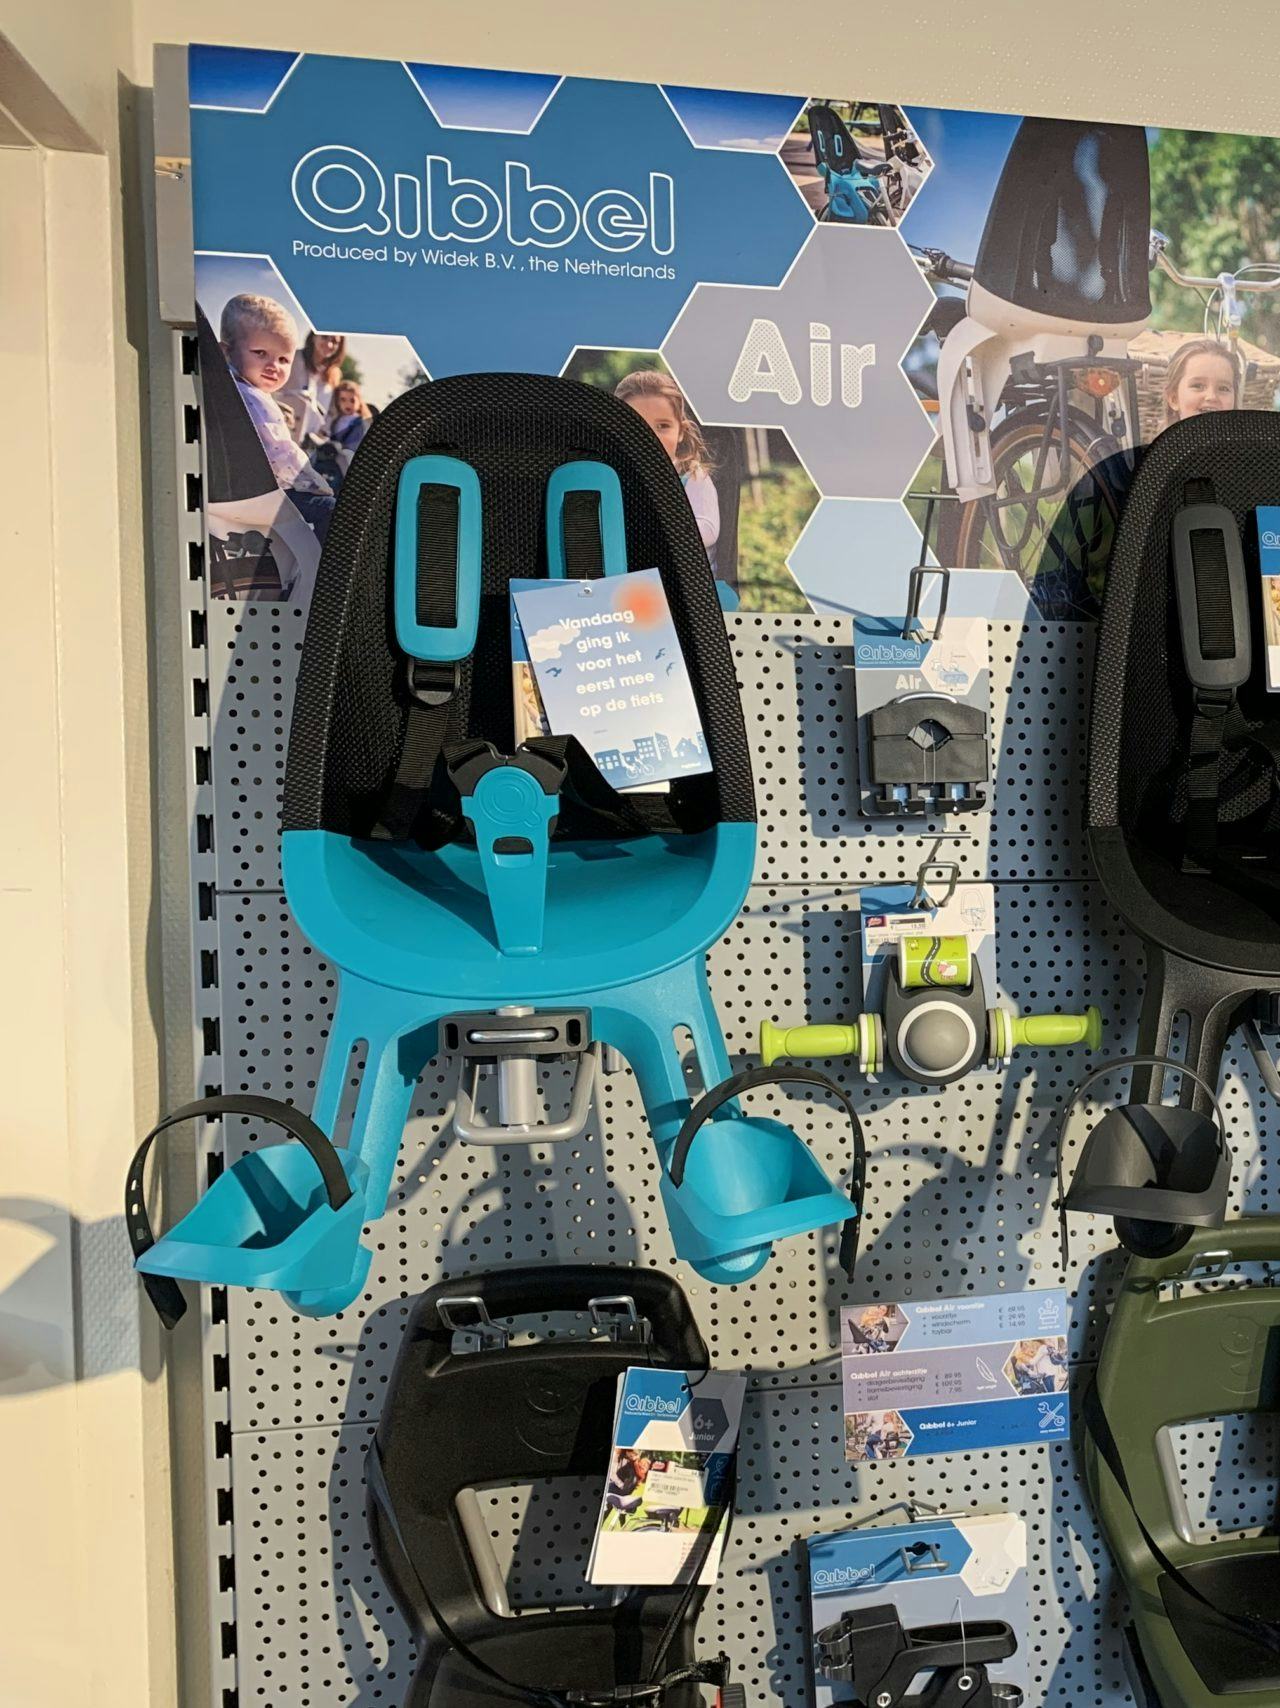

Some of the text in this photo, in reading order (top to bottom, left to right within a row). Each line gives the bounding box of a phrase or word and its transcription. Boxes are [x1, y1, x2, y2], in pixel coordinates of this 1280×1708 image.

[291, 144, 675, 256] Qibbel
[292, 240, 388, 262] Produced
[393, 246, 416, 267] by
[421, 248, 479, 268] Widek
[529, 255, 559, 273] the
[564, 258, 676, 280] Netherlands
[727, 318, 876, 408] Air
[558, 609, 635, 631] Vandaag
[575, 634, 613, 653] ging
[576, 650, 642, 672] voor het
[576, 672, 655, 695] eerst mee
[895, 674, 922, 690] Air
[580, 691, 664, 718] op de fiets
[626, 1393, 681, 1414] Qibbel
[694, 1414, 714, 1430] 6+
[956, 1418, 977, 1427] Junior
[689, 1431, 716, 1441] Junior
